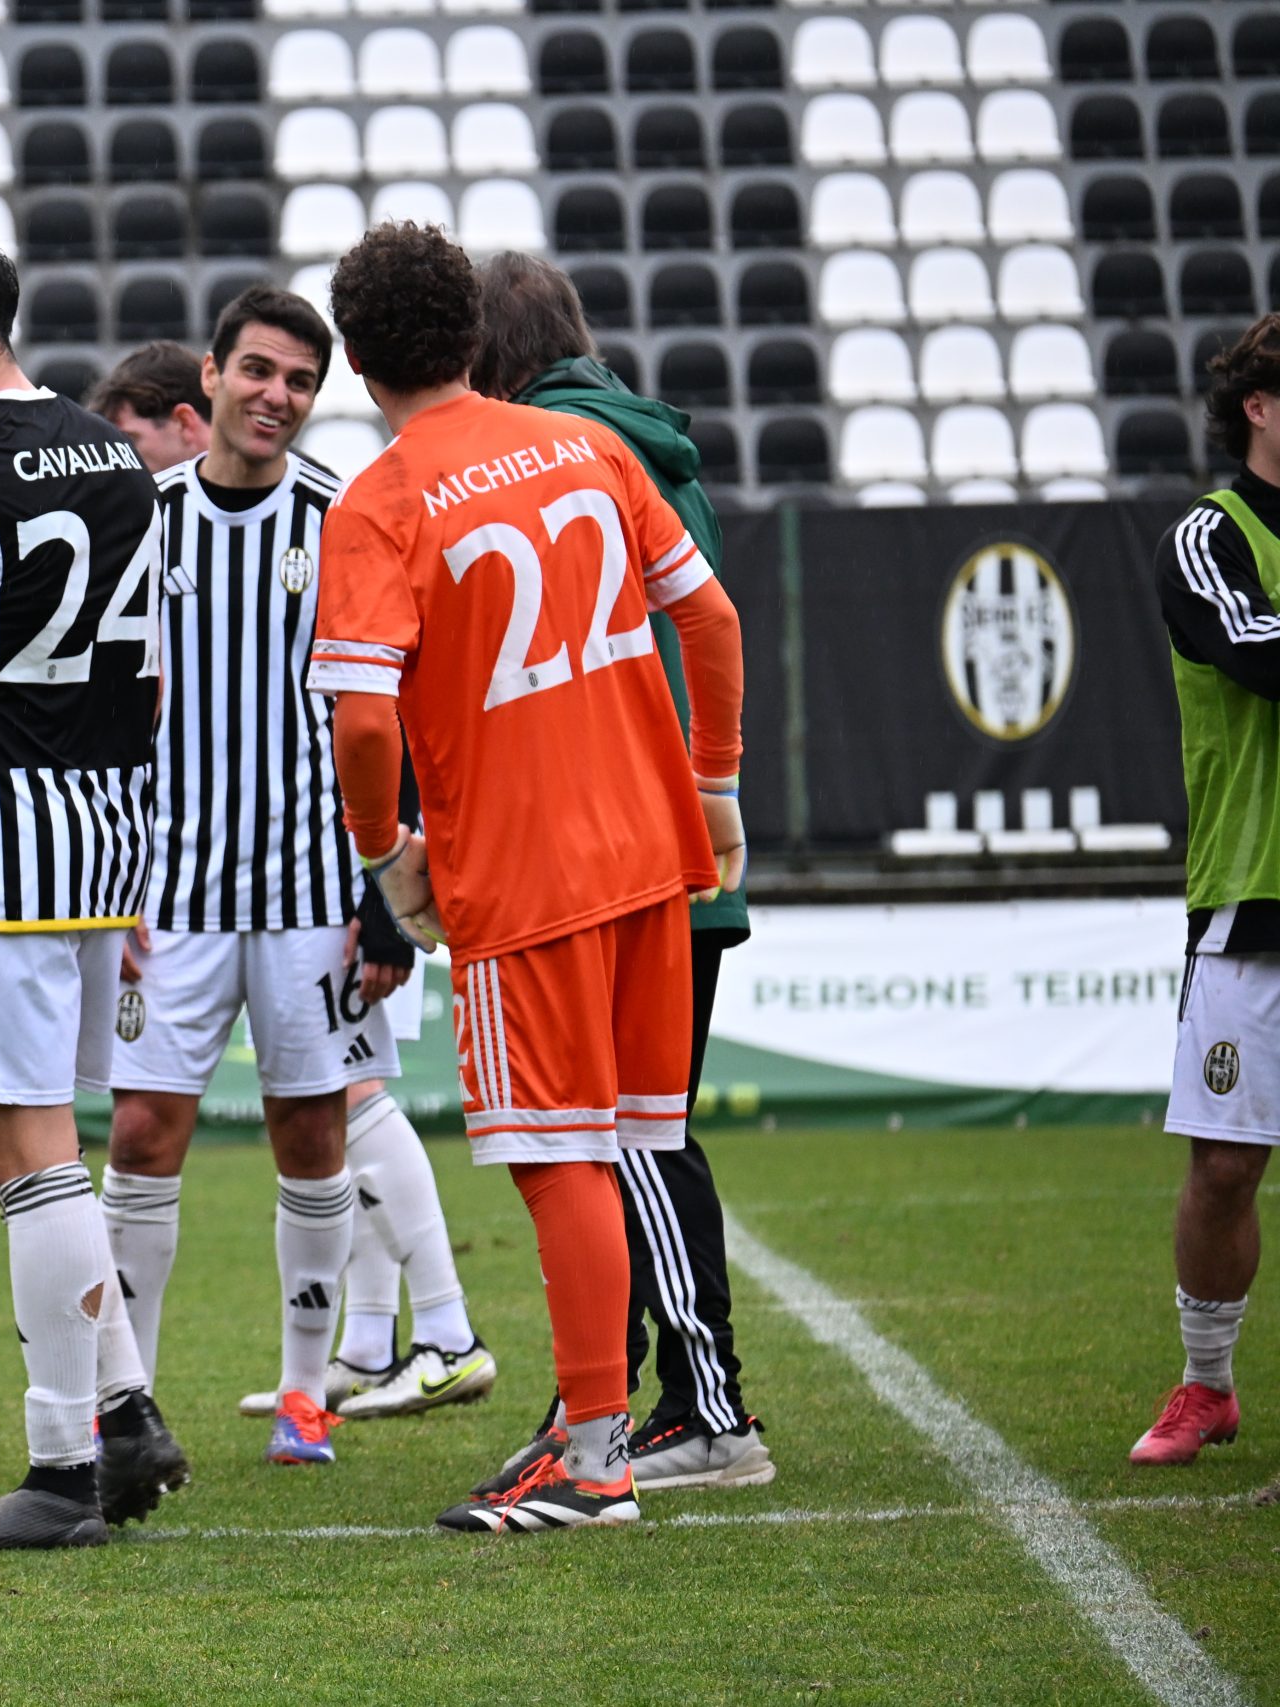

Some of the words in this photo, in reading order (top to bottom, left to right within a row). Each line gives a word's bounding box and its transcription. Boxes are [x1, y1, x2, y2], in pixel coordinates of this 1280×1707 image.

[13, 442, 142, 481] CAVALLARI
[422, 435, 597, 518] MICHIELAN
[442, 488, 654, 712] 22
[316, 960, 370, 1034] 16
[753, 970, 989, 1007] PERSONE
